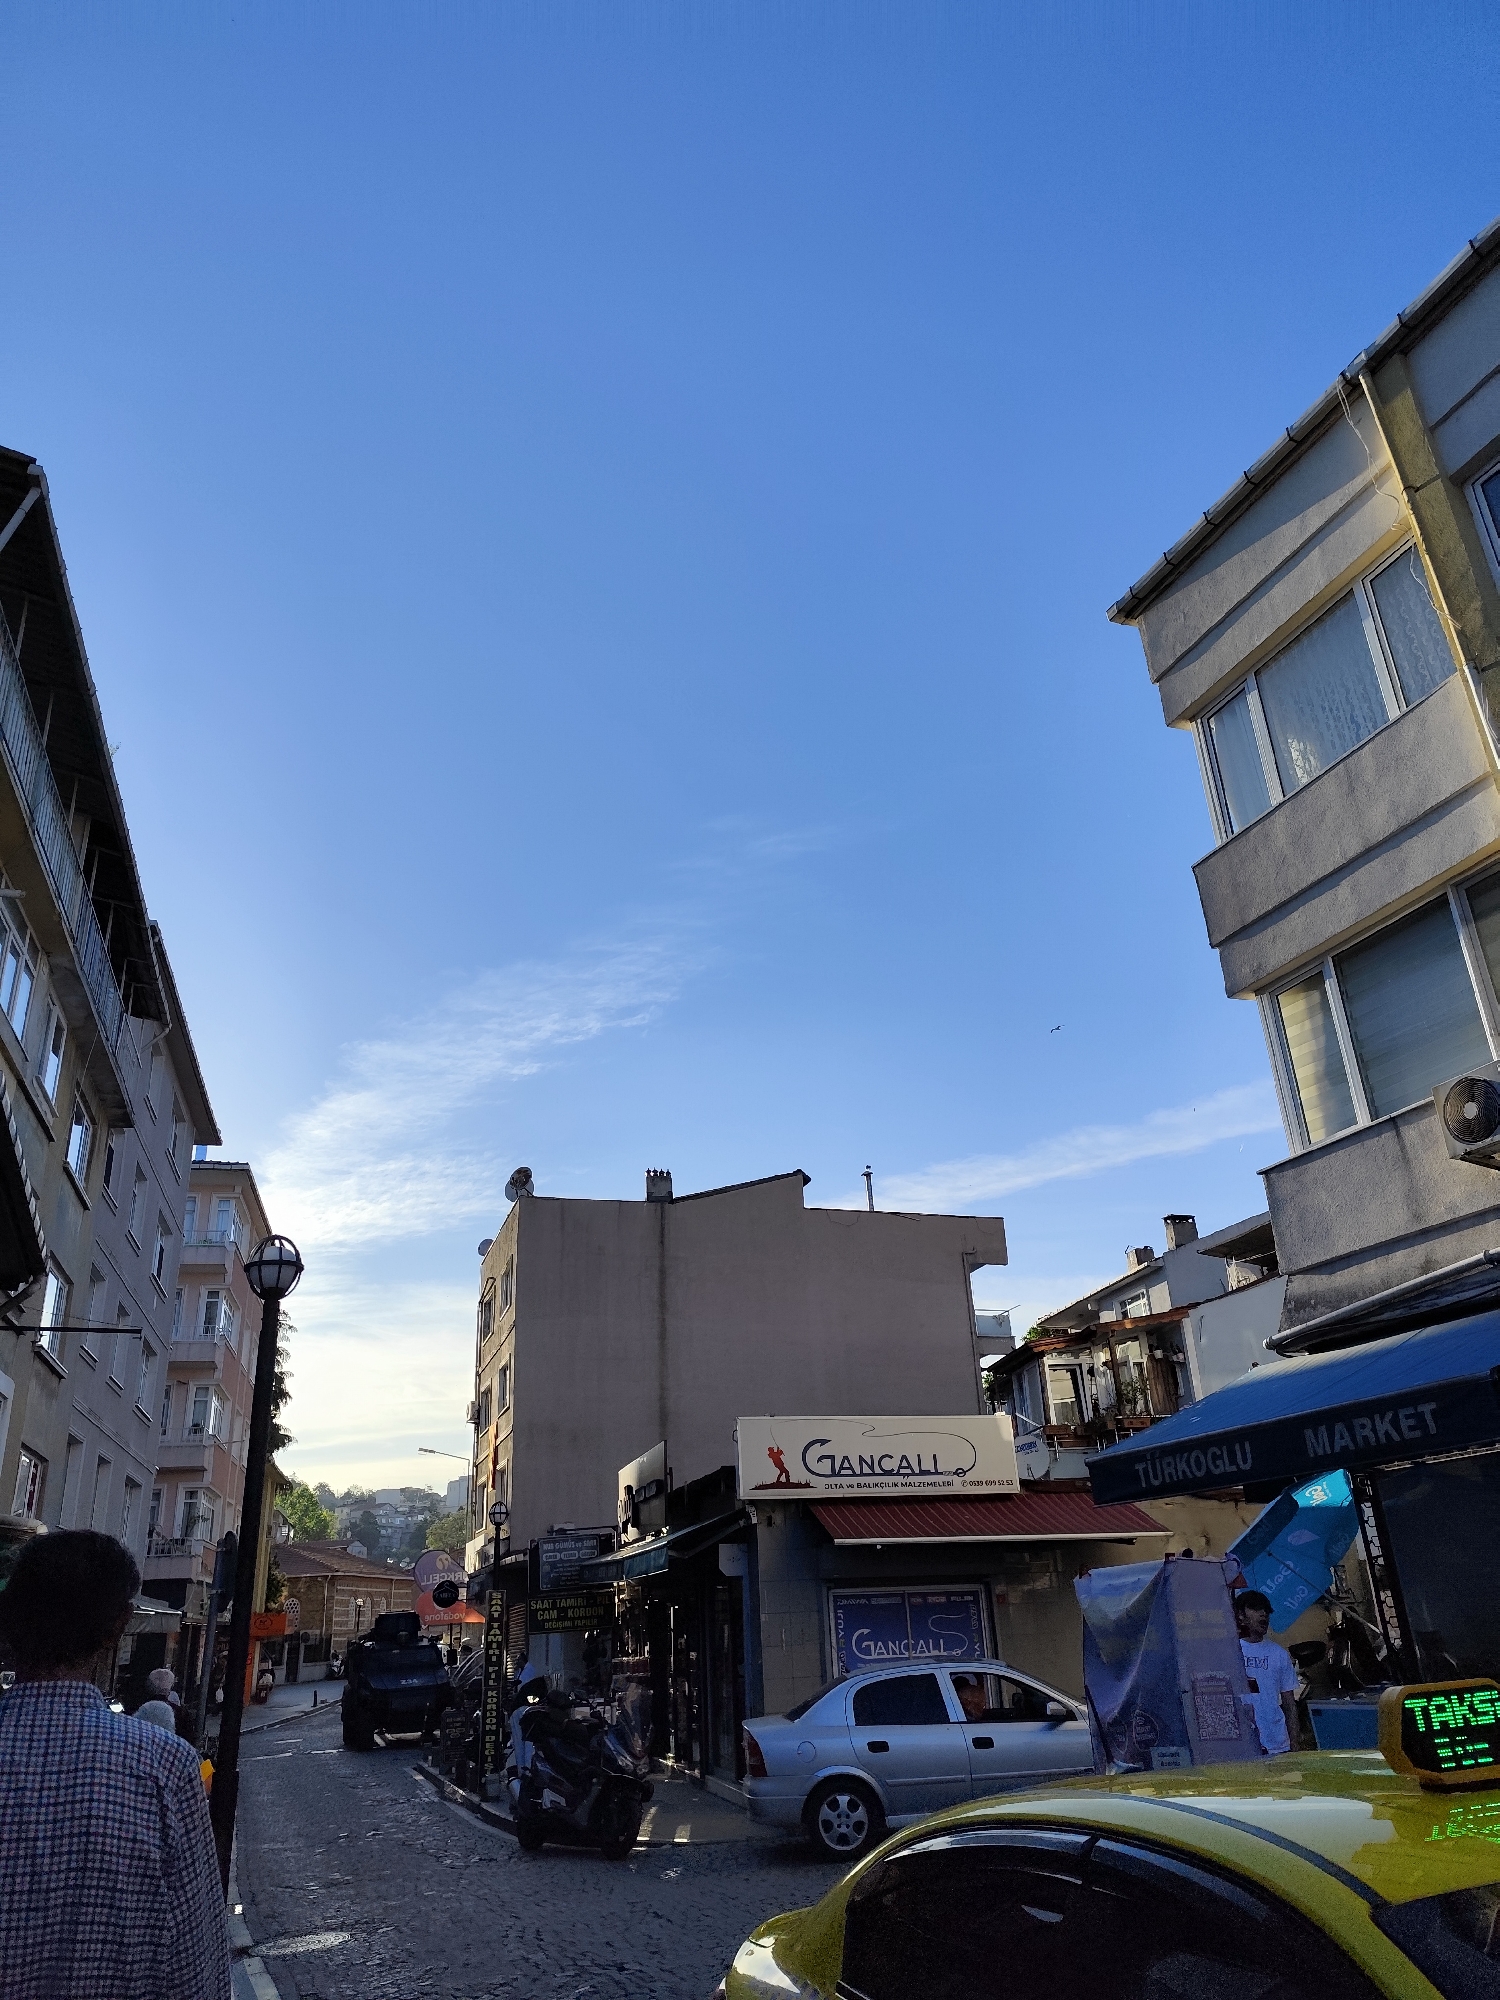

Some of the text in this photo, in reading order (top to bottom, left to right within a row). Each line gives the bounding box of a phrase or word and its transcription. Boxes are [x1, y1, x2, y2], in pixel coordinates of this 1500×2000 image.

[1303, 1401, 1438, 1459] MARKET
[856, 1481, 900, 1490] BALIKÇILIK
[900, 1479, 955, 1489] MALZEMELERİ
[530, 1599, 553, 1610] SAAT
[537, 1609, 558, 1621] CAM
[567, 1606, 604, 1618] KORDON
[485, 1690, 498, 1730] KORDON
